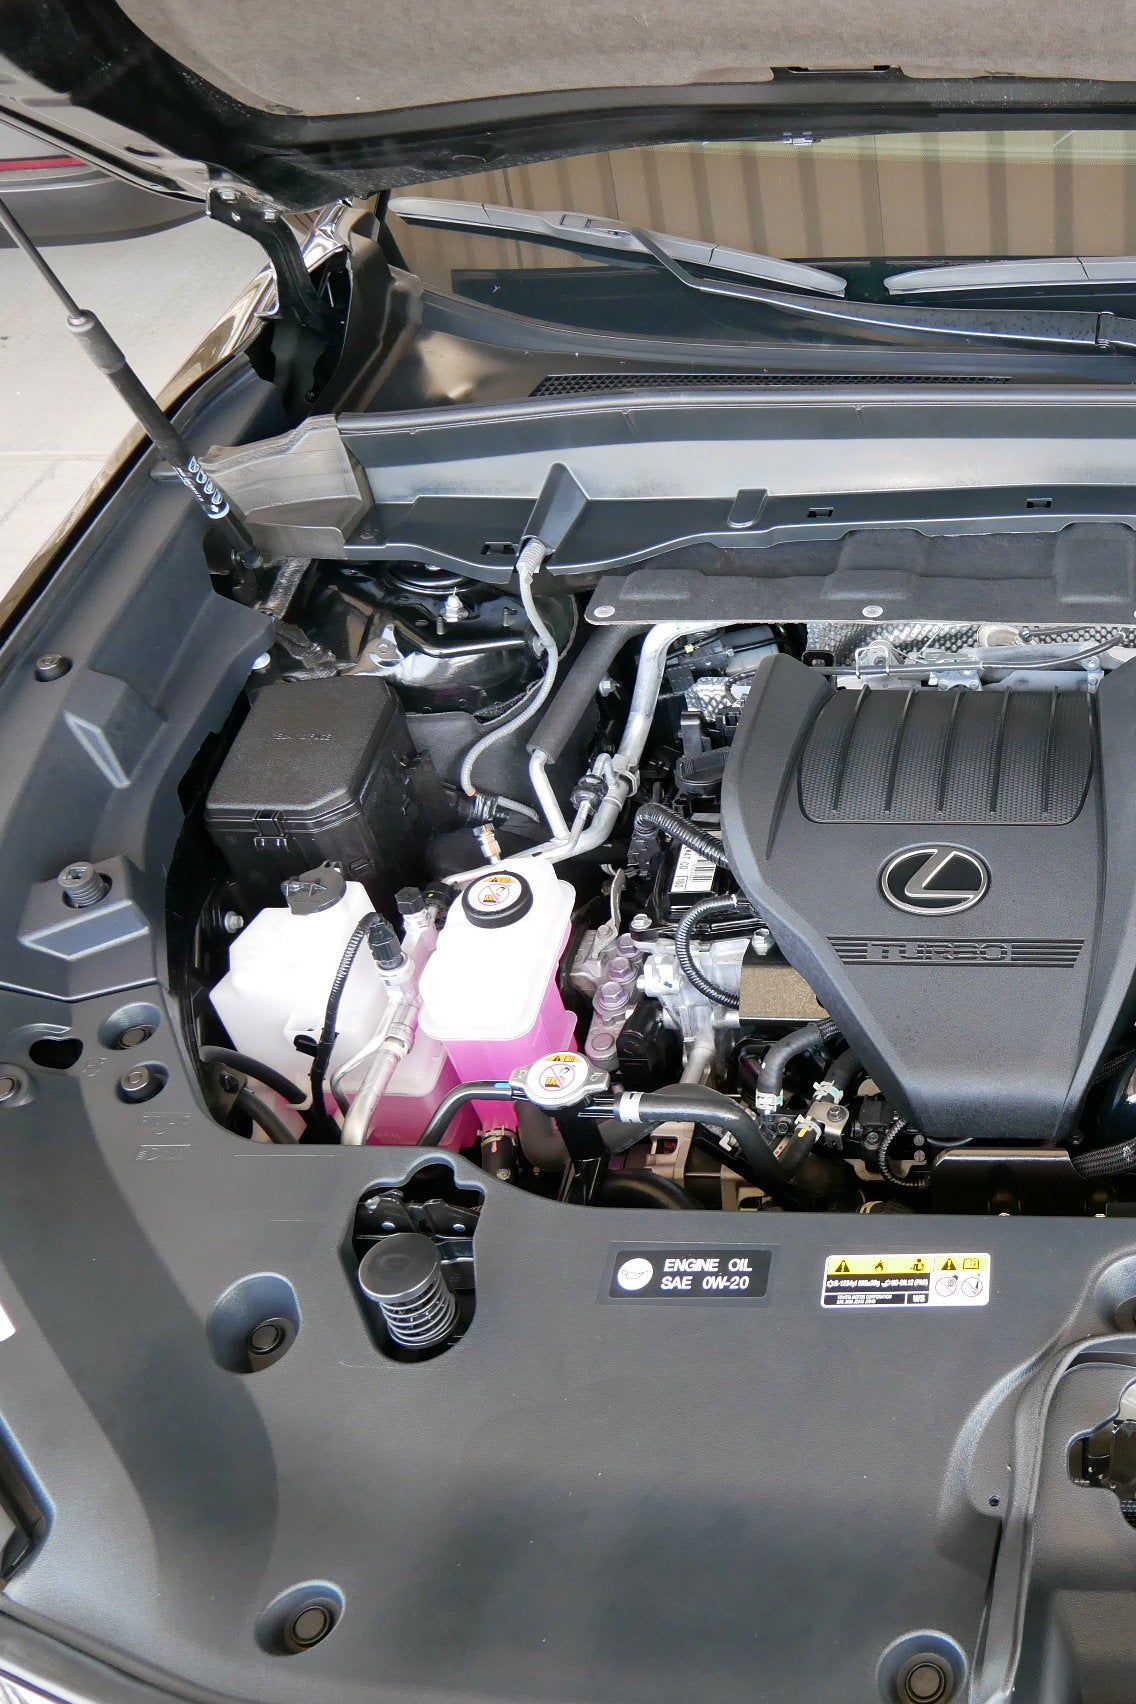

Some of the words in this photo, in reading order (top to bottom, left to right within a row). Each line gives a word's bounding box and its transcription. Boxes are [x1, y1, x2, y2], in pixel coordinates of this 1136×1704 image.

[868, 941, 1008, 960] TURBO
[663, 1258, 720, 1272] ENGINE
[728, 1258, 753, 1272] OIL
[660, 1275, 693, 1290] SAE
[702, 1275, 749, 1290] 0W-20
